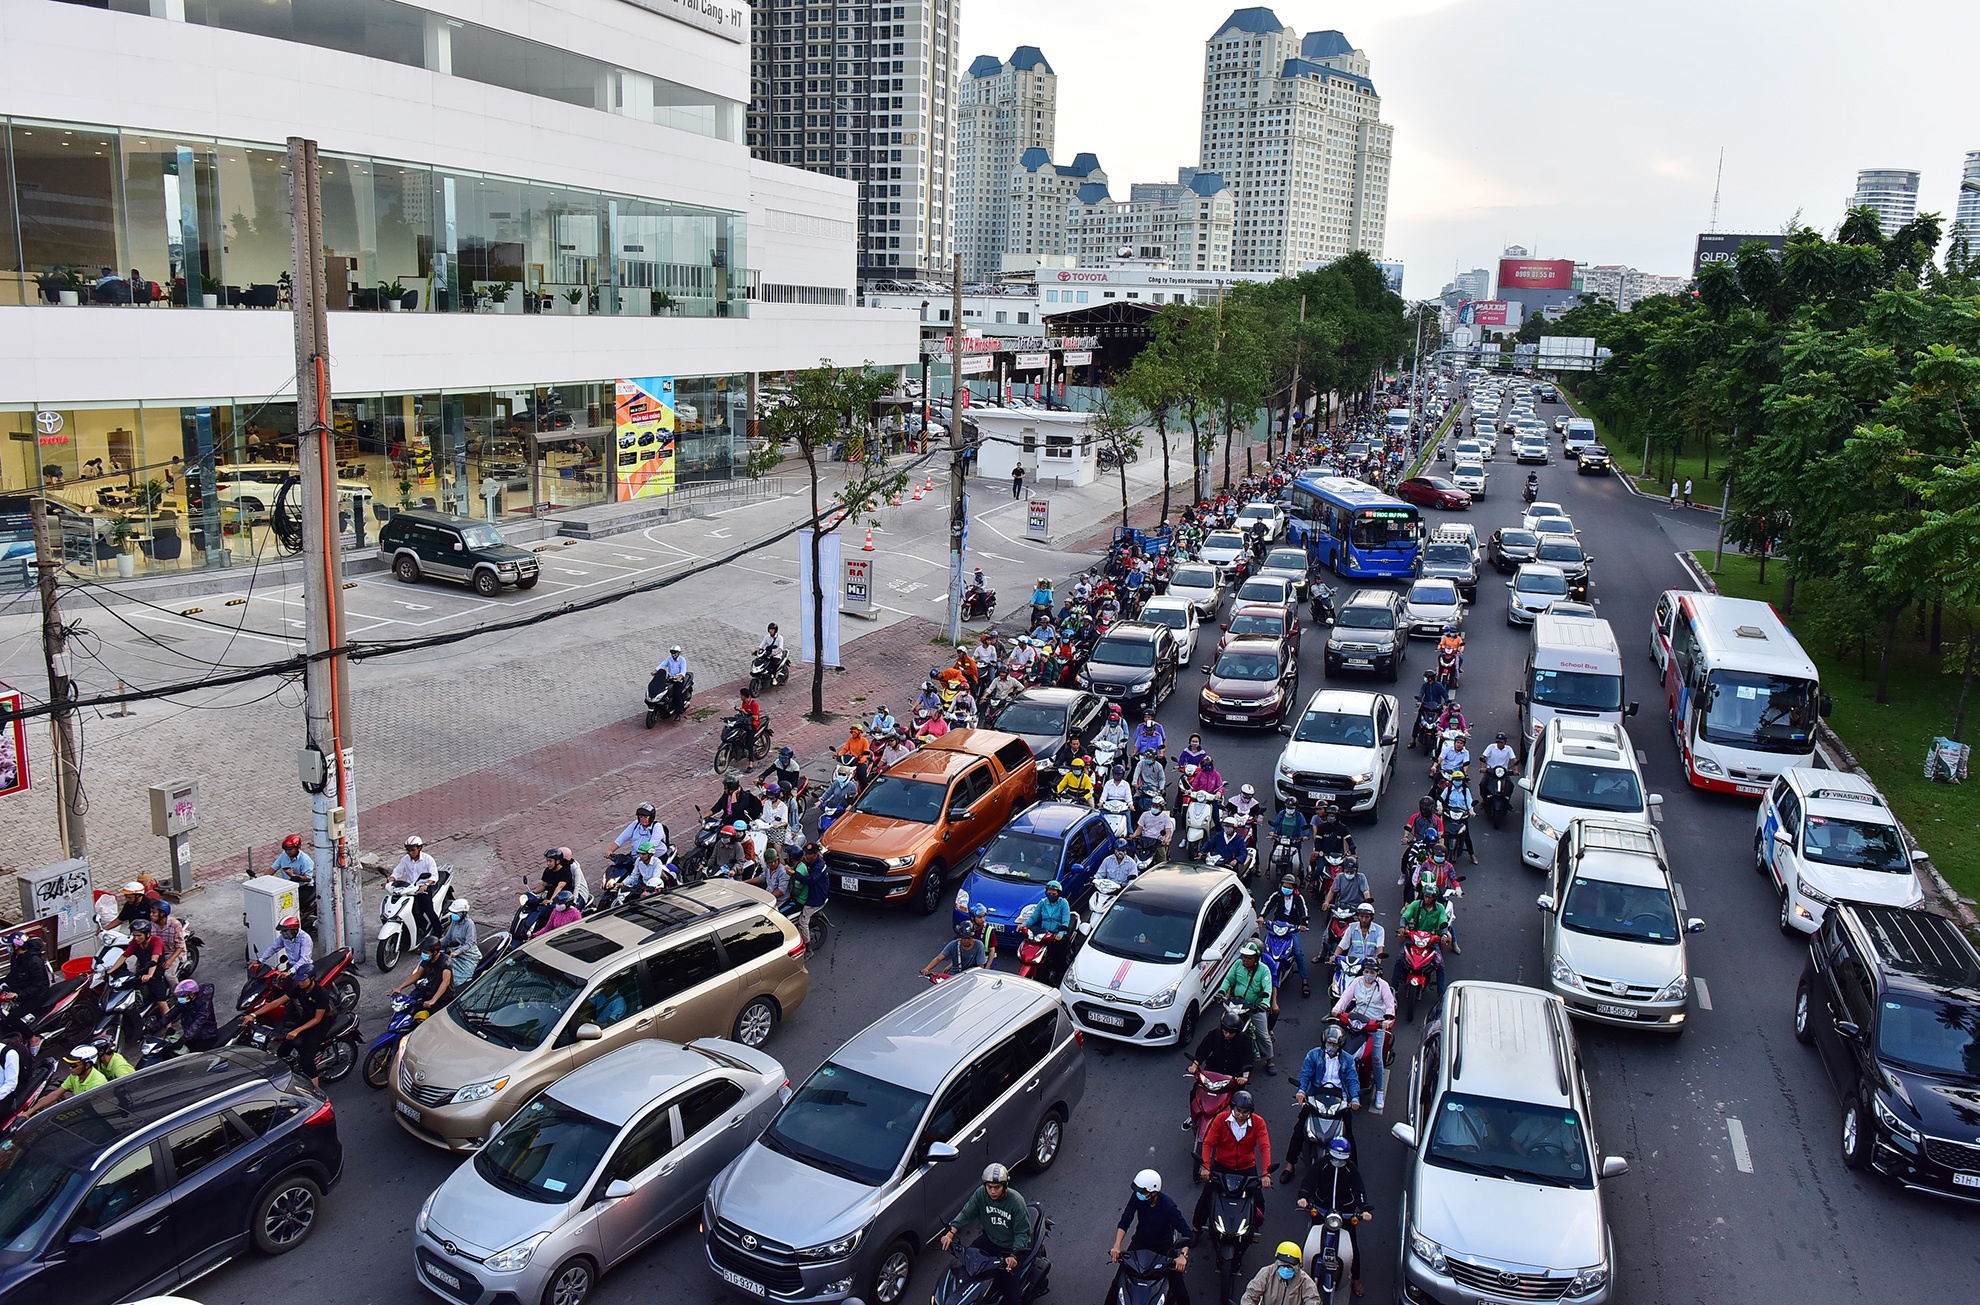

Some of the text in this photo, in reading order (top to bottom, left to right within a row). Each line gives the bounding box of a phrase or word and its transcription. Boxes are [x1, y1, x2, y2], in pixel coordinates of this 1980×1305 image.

[731, 8, 743, 28] HT
[903, 133, 918, 146] LP
[1700, 252, 1729, 262] QLED
[1072, 273, 1108, 282] TOYOTA
[849, 568, 863, 577] RA
[847, 584, 865, 595] HT
